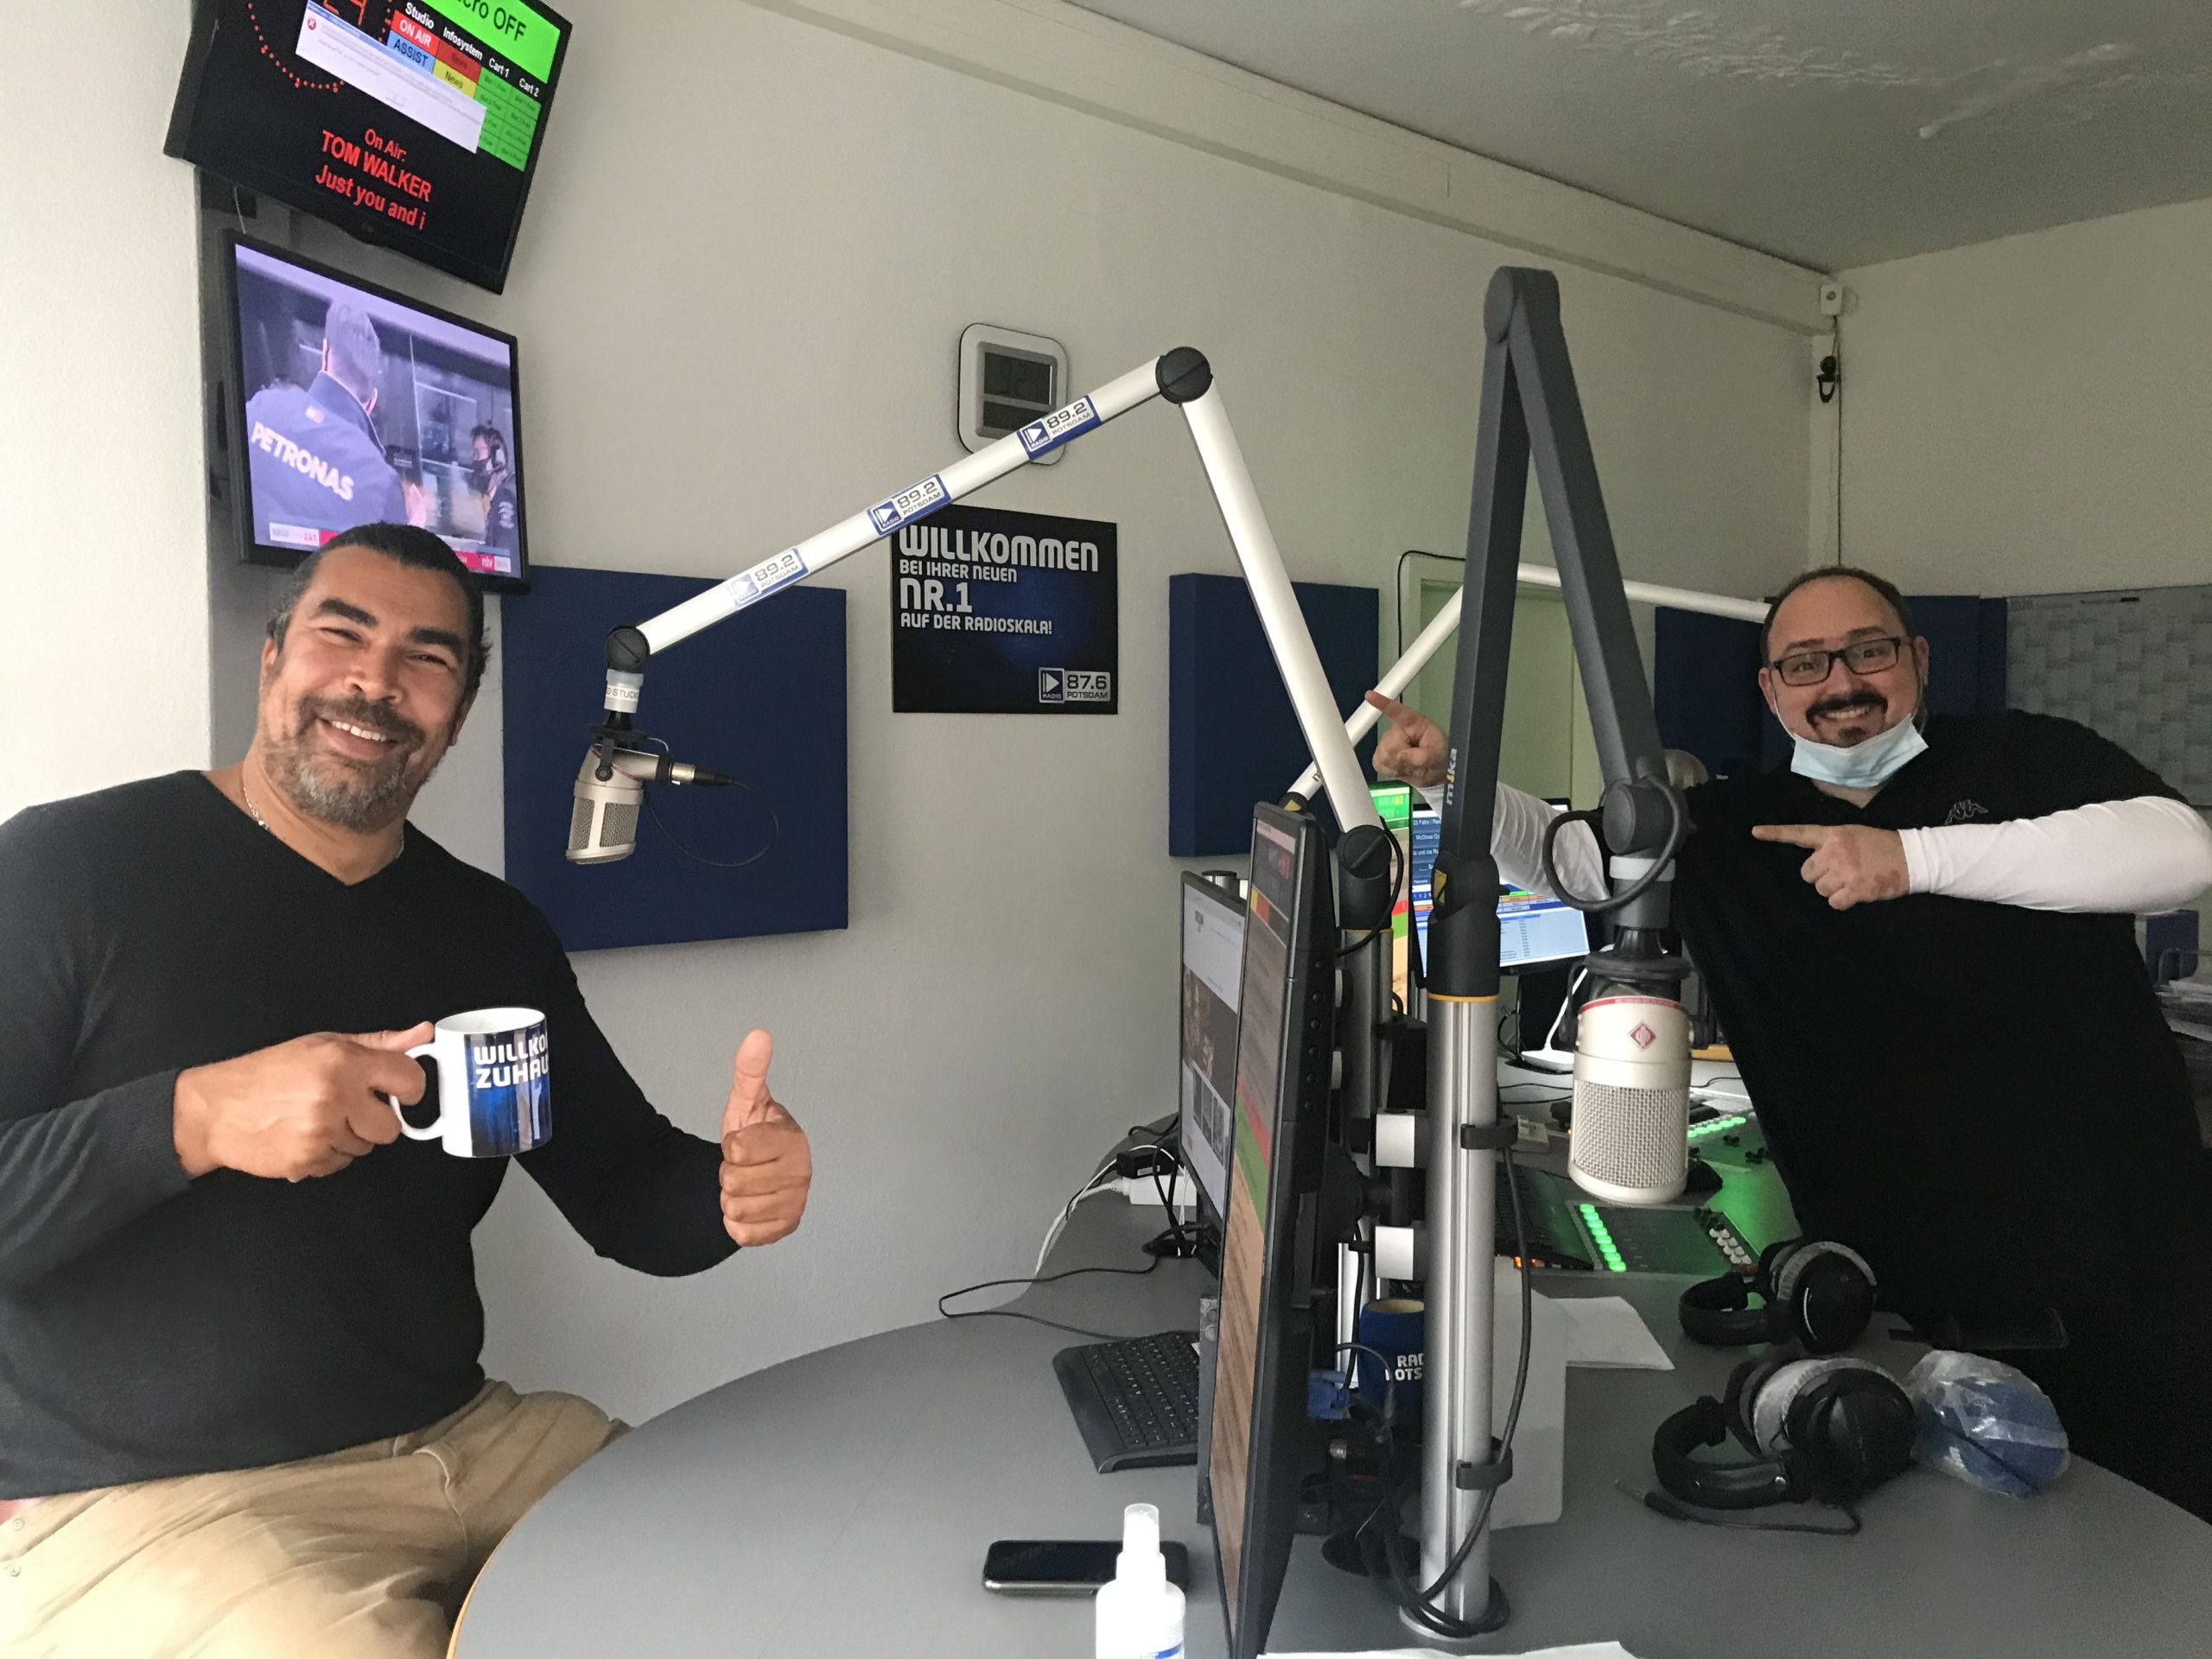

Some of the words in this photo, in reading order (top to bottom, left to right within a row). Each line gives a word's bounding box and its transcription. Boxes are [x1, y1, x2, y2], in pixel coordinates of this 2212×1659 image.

[404, 2, 435, 29] Studio
[493, 7, 526, 41] OFF
[399, 19, 415, 37] ON
[415, 29, 432, 48] AIR
[443, 27, 483, 61] Infosystem
[393, 39, 429, 67] ASSIST
[445, 70, 463, 89] News
[489, 57, 505, 76] Cart
[505, 67, 510, 79] 1
[519, 77, 534, 94] Cart
[533, 86, 539, 98] 2
[364, 128, 383, 151] On
[384, 139, 407, 162] Air:
[322, 129, 360, 168] TOM
[363, 150, 432, 202] WALKER
[315, 164, 353, 197] Just
[353, 185, 385, 212] you
[387, 201, 418, 226] and
[418, 211, 427, 230] i
[1046, 402, 1088, 429] 89.2
[1052, 412, 1090, 435] POTSDAM
[251, 421, 355, 501] PETRONAS
[897, 481, 938, 509] 89.2
[903, 492, 941, 515] POTSDAM
[882, 516, 899, 528] RADIO
[899, 524, 1099, 572] WILLKOMMEN
[481, 556, 493, 568] ntv
[754, 554, 796, 582] 89.2
[899, 559, 923, 575] BEI
[926, 562, 969, 580] IHRER
[972, 566, 1017, 583] NEUEN
[760, 565, 799, 588] POTSDAM
[899, 577, 972, 613] NR.1
[900, 613, 930, 628] AUF
[933, 614, 961, 630] DER
[965, 616, 1052, 635] RADIOSKALA!
[1067, 674, 1107, 690] 87.6
[474, 1032, 549, 1065] WILLKO
